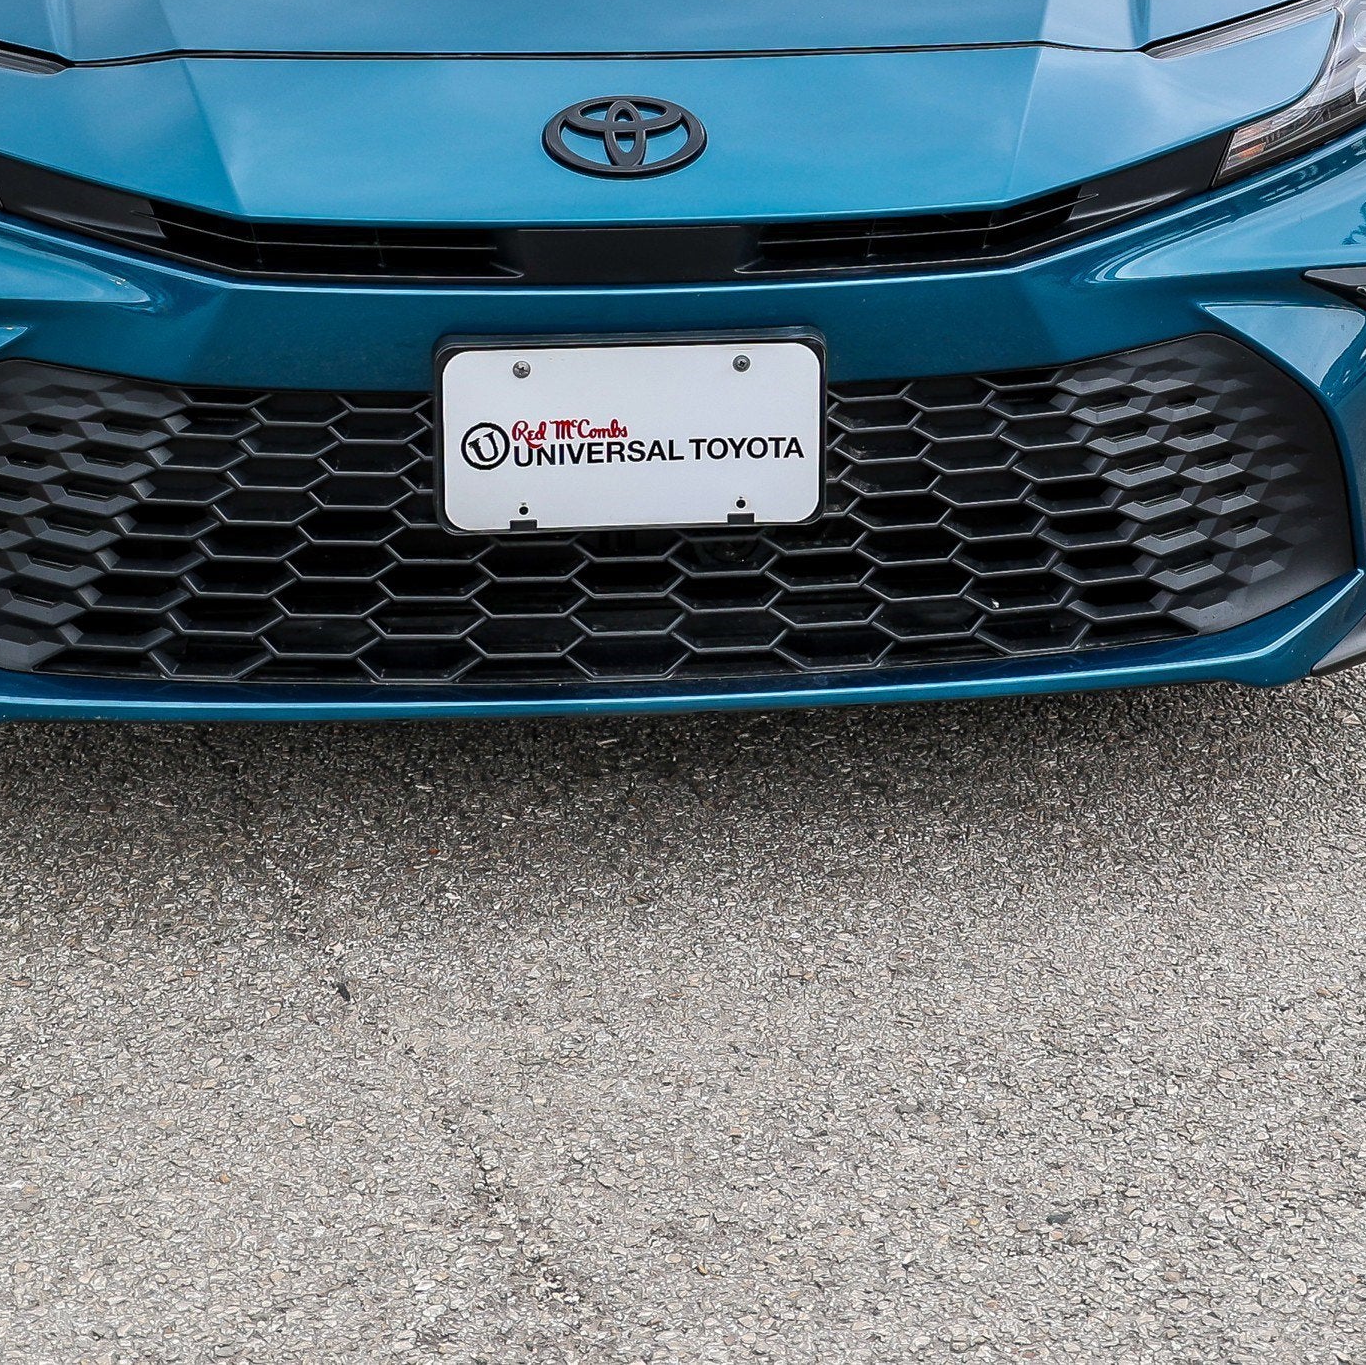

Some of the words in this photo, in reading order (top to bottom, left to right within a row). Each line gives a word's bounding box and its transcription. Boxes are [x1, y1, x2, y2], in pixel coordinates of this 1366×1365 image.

[512, 420, 547, 448] Red
[550, 418, 628, 439] McCombs
[513, 439, 684, 467] UNIVERSAL
[688, 436, 805, 461] TOYOTA
